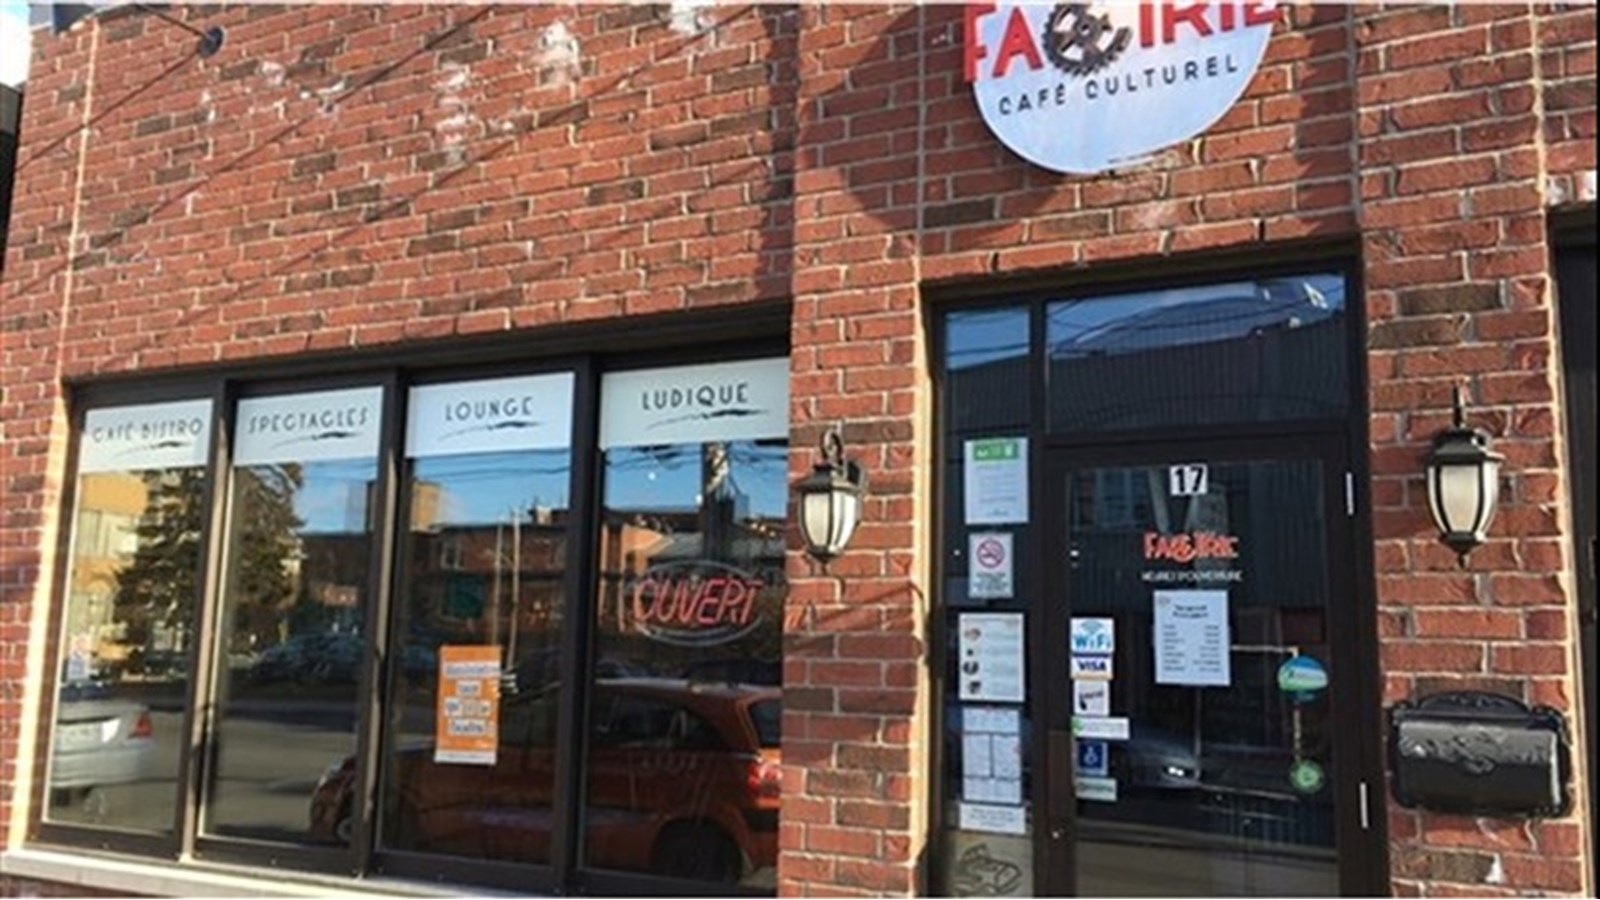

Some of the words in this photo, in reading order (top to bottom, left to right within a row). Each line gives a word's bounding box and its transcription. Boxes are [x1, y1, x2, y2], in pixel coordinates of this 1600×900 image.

[999, 83, 1066, 116] CAFÉ
[1085, 54, 1238, 99] CULTUREL
[445, 396, 534, 422] LOUNGE
[641, 383, 749, 410] LUDIQUE
[248, 406, 368, 435] SPECTACLES
[1174, 466, 1204, 493] 17
[634, 577, 764, 625] OUVERT
[1078, 660, 1107, 671] VISA
